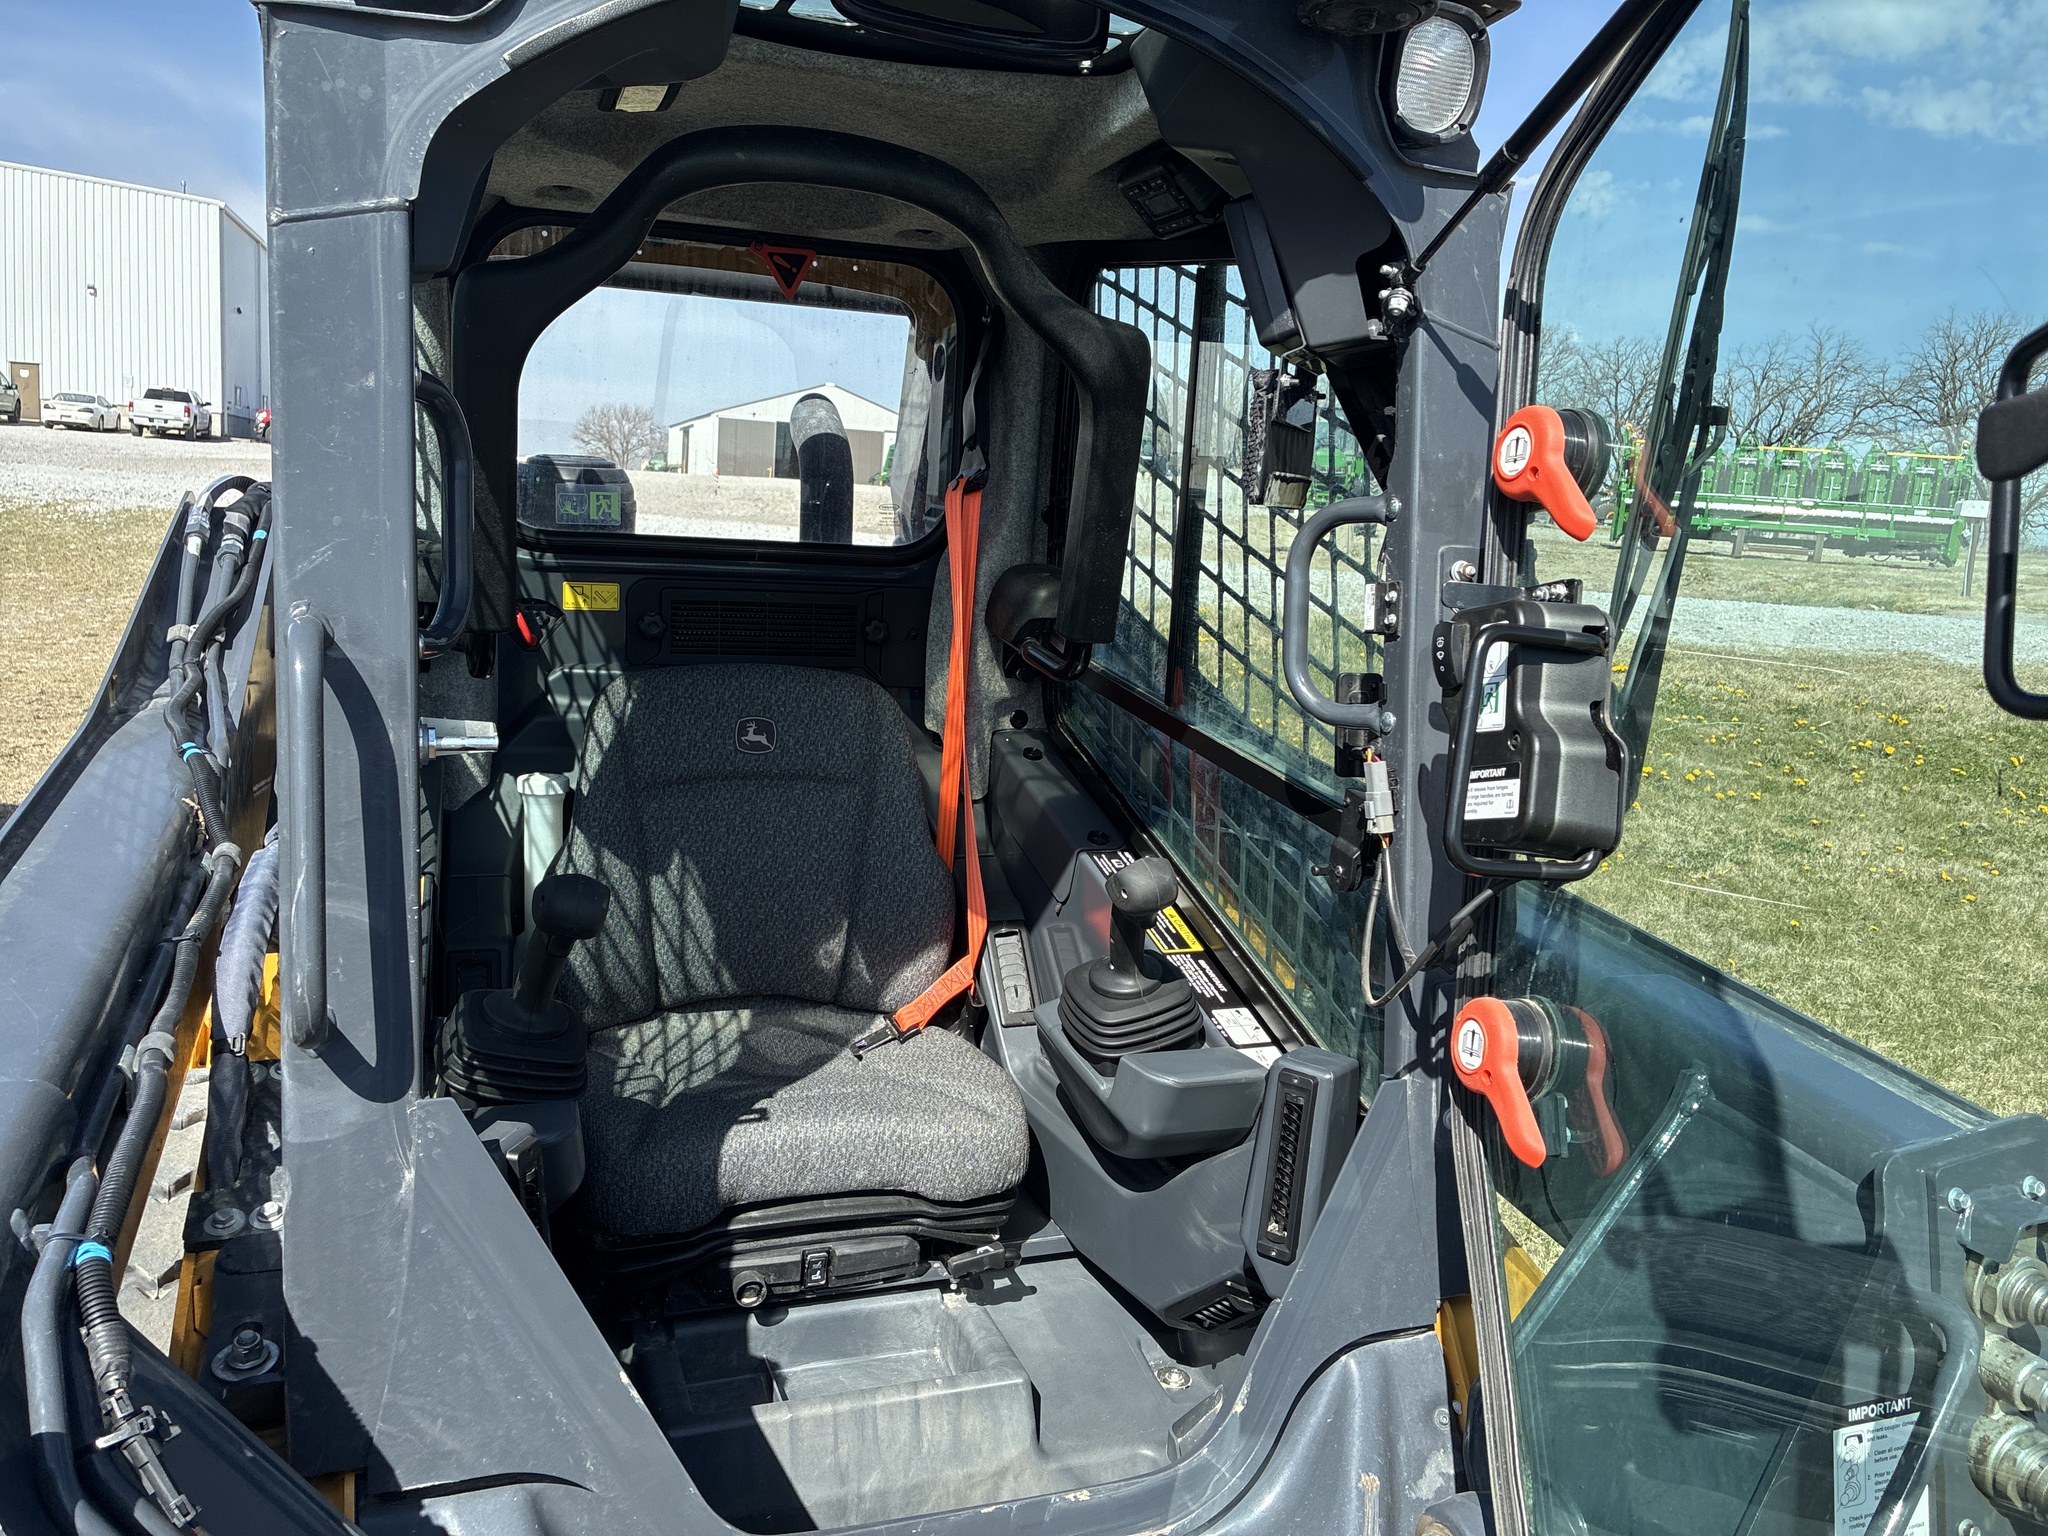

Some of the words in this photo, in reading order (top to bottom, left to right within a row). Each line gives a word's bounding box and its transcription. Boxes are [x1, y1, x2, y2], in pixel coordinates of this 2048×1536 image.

[1173, 917, 1198, 946] CAUTION
[1198, 959, 1228, 992] IMPORTANT
[1848, 1396, 1913, 1422] IMPORTANT
[1866, 1426, 1884, 1435] Prevent
[1884, 1422, 1901, 1431] coupler
[1873, 1448, 1887, 1457] Clean
[1873, 1455, 1889, 1464] before
[1874, 1471, 1886, 1479] Prior
[1848, 1513, 1863, 1523] Check
[1848, 1521, 1866, 1530] routing.
